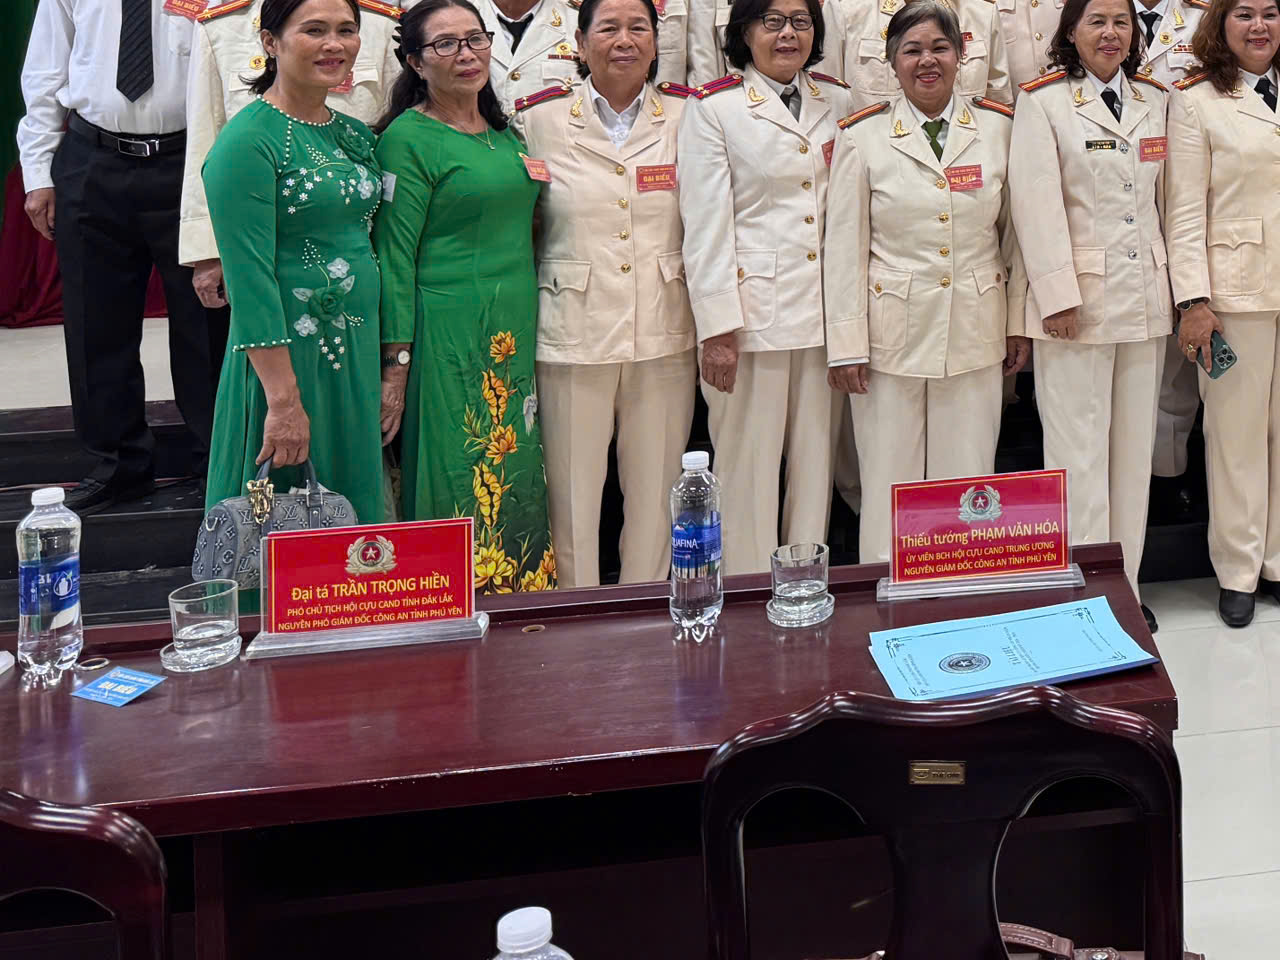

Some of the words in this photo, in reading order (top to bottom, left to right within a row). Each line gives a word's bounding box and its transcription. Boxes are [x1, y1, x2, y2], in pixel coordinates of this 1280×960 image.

[901, 531, 930, 548] Thiếu
[934, 532, 968, 546] tướng
[971, 528, 1005, 542] PHẠM
[1008, 524, 1032, 537] VĂN
[1034, 519, 1059, 534] HÓA
[904, 564, 934, 575] NGUYÊN
[936, 562, 956, 572] GIÁM
[958, 559, 973, 570] ĐỐC
[975, 558, 995, 568] CÔNG
[997, 558, 1007, 567] AN
[1009, 555, 1025, 565] TỈNH
[1027, 553, 1041, 564] PHÚ
[1043, 552, 1056, 561] YÊN
[906, 552, 916, 562] ỦY
[919, 551, 934, 561] VIÊN
[936, 551, 950, 560] BCH
[952, 548, 965, 559] HỘI
[967, 548, 982, 558] CỰU
[984, 547, 1004, 555] CAND
[1006, 544, 1030, 553] TRUNG
[1032, 541, 1054, 550] ƯƠNG
[292, 586, 313, 600] Đại
[317, 584, 328, 597] tá
[332, 578, 368, 597] TRẦN
[370, 578, 416, 594] TRỌNG
[420, 571, 449, 590] HIỀN
[288, 607, 304, 616] PHÓ
[307, 604, 322, 614] CHỦ
[325, 602, 341, 613] TỊCH
[344, 601, 357, 612] HỘI
[359, 600, 377, 612] CỰU
[379, 598, 400, 608] CAND
[403, 595, 419, 605] TỈNH
[421, 593, 437, 604] ĐẮK
[439, 592, 453, 603] LẮK
[278, 620, 310, 630] NGUYÊN
[313, 617, 329, 627] PHÓ
[332, 615, 352, 625] GIÁM
[354, 612, 371, 624] ĐỐC
[373, 611, 394, 621] CÔNG
[397, 612, 408, 620] AN
[411, 609, 429, 619] TỈNH
[432, 607, 447, 617] PHÚ
[448, 605, 462, 616] YÊN
